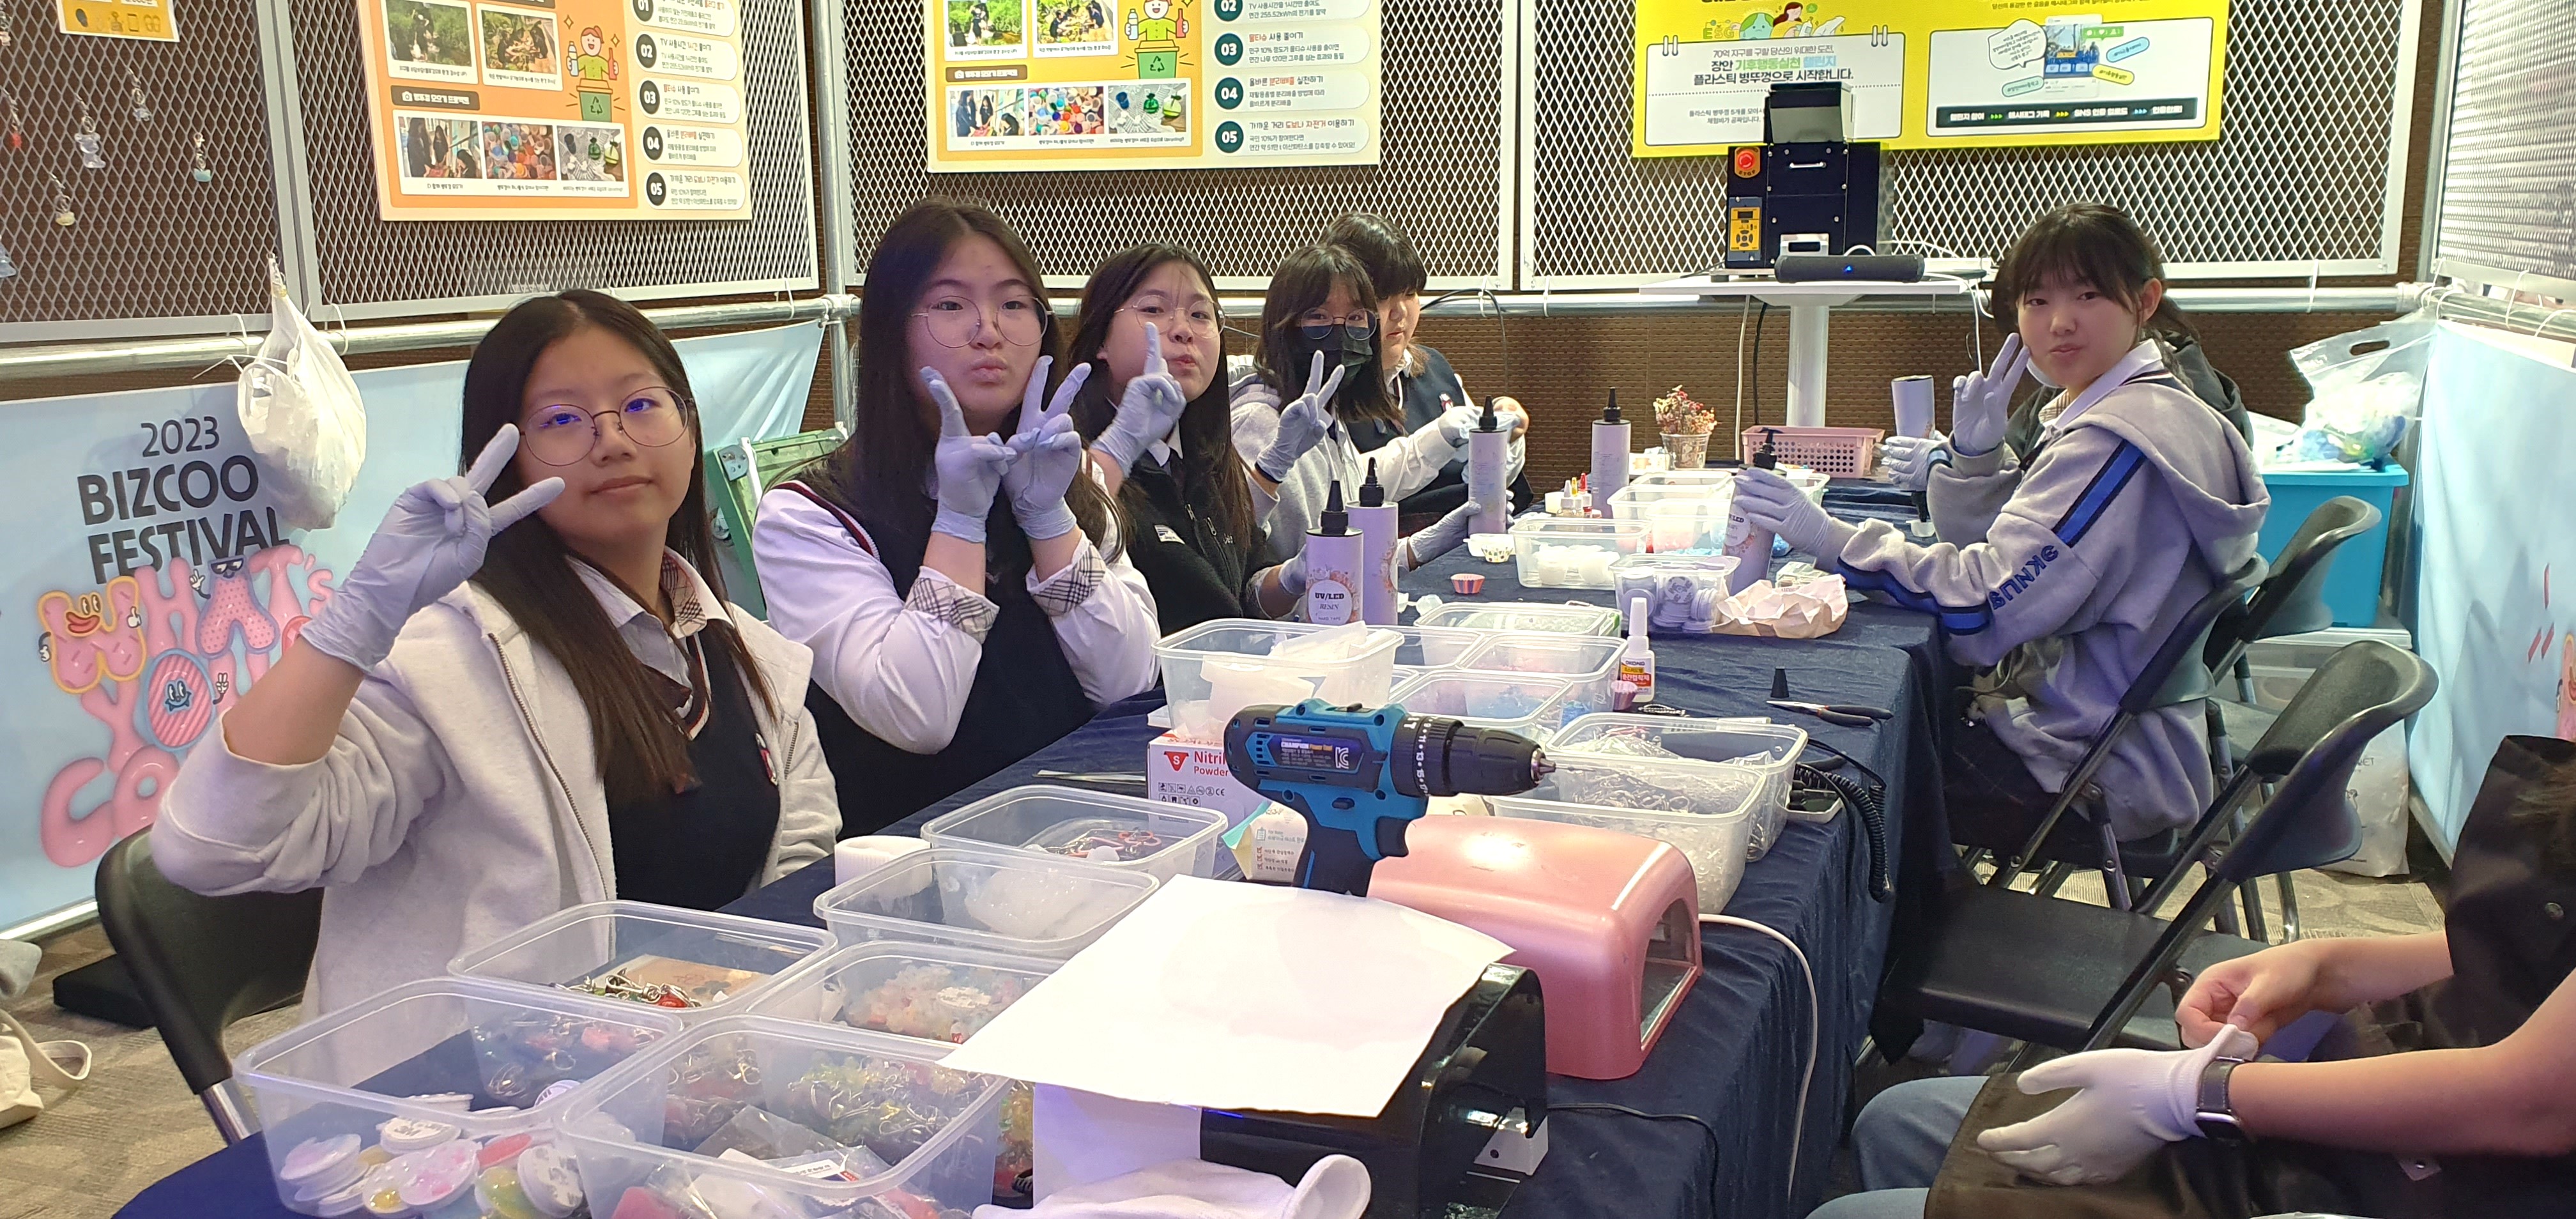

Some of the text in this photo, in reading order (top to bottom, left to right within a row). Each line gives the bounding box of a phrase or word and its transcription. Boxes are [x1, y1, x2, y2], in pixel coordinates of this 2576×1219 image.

[1221, 0, 1236, 12] 02
[1269, 33, 1281, 41] 사용
[1703, 26, 1734, 39] ESG
[660, 38, 668, 46] TV
[641, 44, 653, 58] 02
[1221, 43, 1236, 56] 03
[1713, 49, 1729, 58] 70억
[1731, 49, 1752, 57] 지구를
[1754, 48, 1769, 56] 구할
[1771, 47, 1792, 55] 당신의
[1794, 45, 1816, 54] 위대한
[1711, 61, 1733, 72] 장안
[1735, 57, 1800, 70] 기후행동실천
[1250, 77, 1268, 87] 올바른
[1297, 75, 1323, 85] 실천하기
[1694, 68, 1853, 86] 플라스틱 병뚜껑으로 시작합니다.
[643, 91, 656, 104] 03
[1222, 88, 1238, 100] 04
[2074, 109, 2091, 117] SNS
[1250, 121, 1269, 130] 가까운
[1285, 120, 1304, 128] 도보나
[1305, 119, 1326, 129] 자전거
[1328, 119, 1354, 128] 이용하기
[1707, 116, 1729, 124] 체험비가
[647, 137, 660, 150] 04
[1222, 131, 1238, 144] 05
[650, 183, 663, 195] 05
[141, 416, 220, 458] 2023
[77, 454, 259, 526] BIZCOO
[86, 506, 290, 585] FESTIVAL
[1315, 592, 1344, 601] UV/LED
[1173, 756, 1180, 765] S
[1194, 751, 1225, 765] Nitril
[1416, 751, 1424, 761] 13
[1194, 766, 1229, 776] Powder
[1416, 769, 1425, 778] 15
